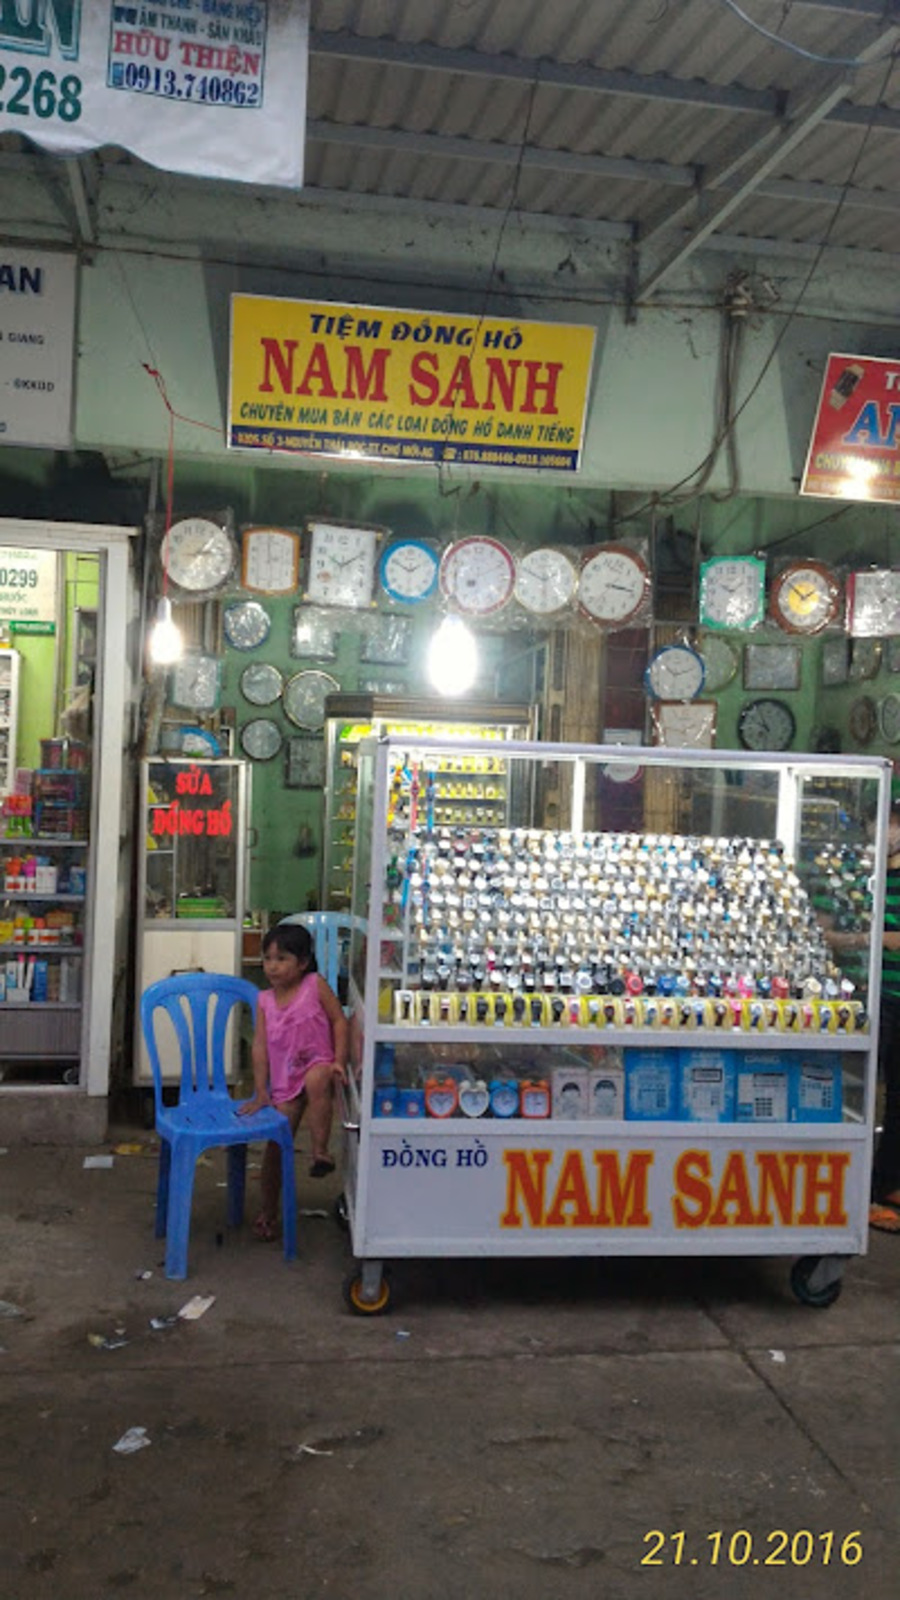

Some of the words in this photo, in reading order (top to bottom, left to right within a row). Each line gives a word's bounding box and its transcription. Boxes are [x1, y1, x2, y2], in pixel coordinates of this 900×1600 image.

[160, 14, 197, 34] THANH
[207, 18, 230, 40] SÂN
[114, 29, 171, 62] HỮU
[180, 42, 262, 77] THIỆN
[0, 63, 82, 122] 268
[125, 62, 259, 105] 0913.740862
[8, 332, 44, 345] GIANG
[310, 313, 383, 340] TIỆM
[258, 337, 392, 402] NAM
[408, 350, 564, 415] SANH
[240, 401, 295, 422] CHUYÊN
[297, 406, 328, 425] MUA
[333, 407, 363, 427] BÁN
[368, 408, 394, 430] CÁC
[496, 421, 534, 440] DANH
[537, 420, 575, 444] TIẾNG
[175, 763, 213, 795] SỬA
[382, 1139, 448, 1168] ĐỒNG
[456, 1138, 489, 1168] HỒ
[499, 1148, 654, 1229] NAM
[670, 1148, 851, 1229] SANH
